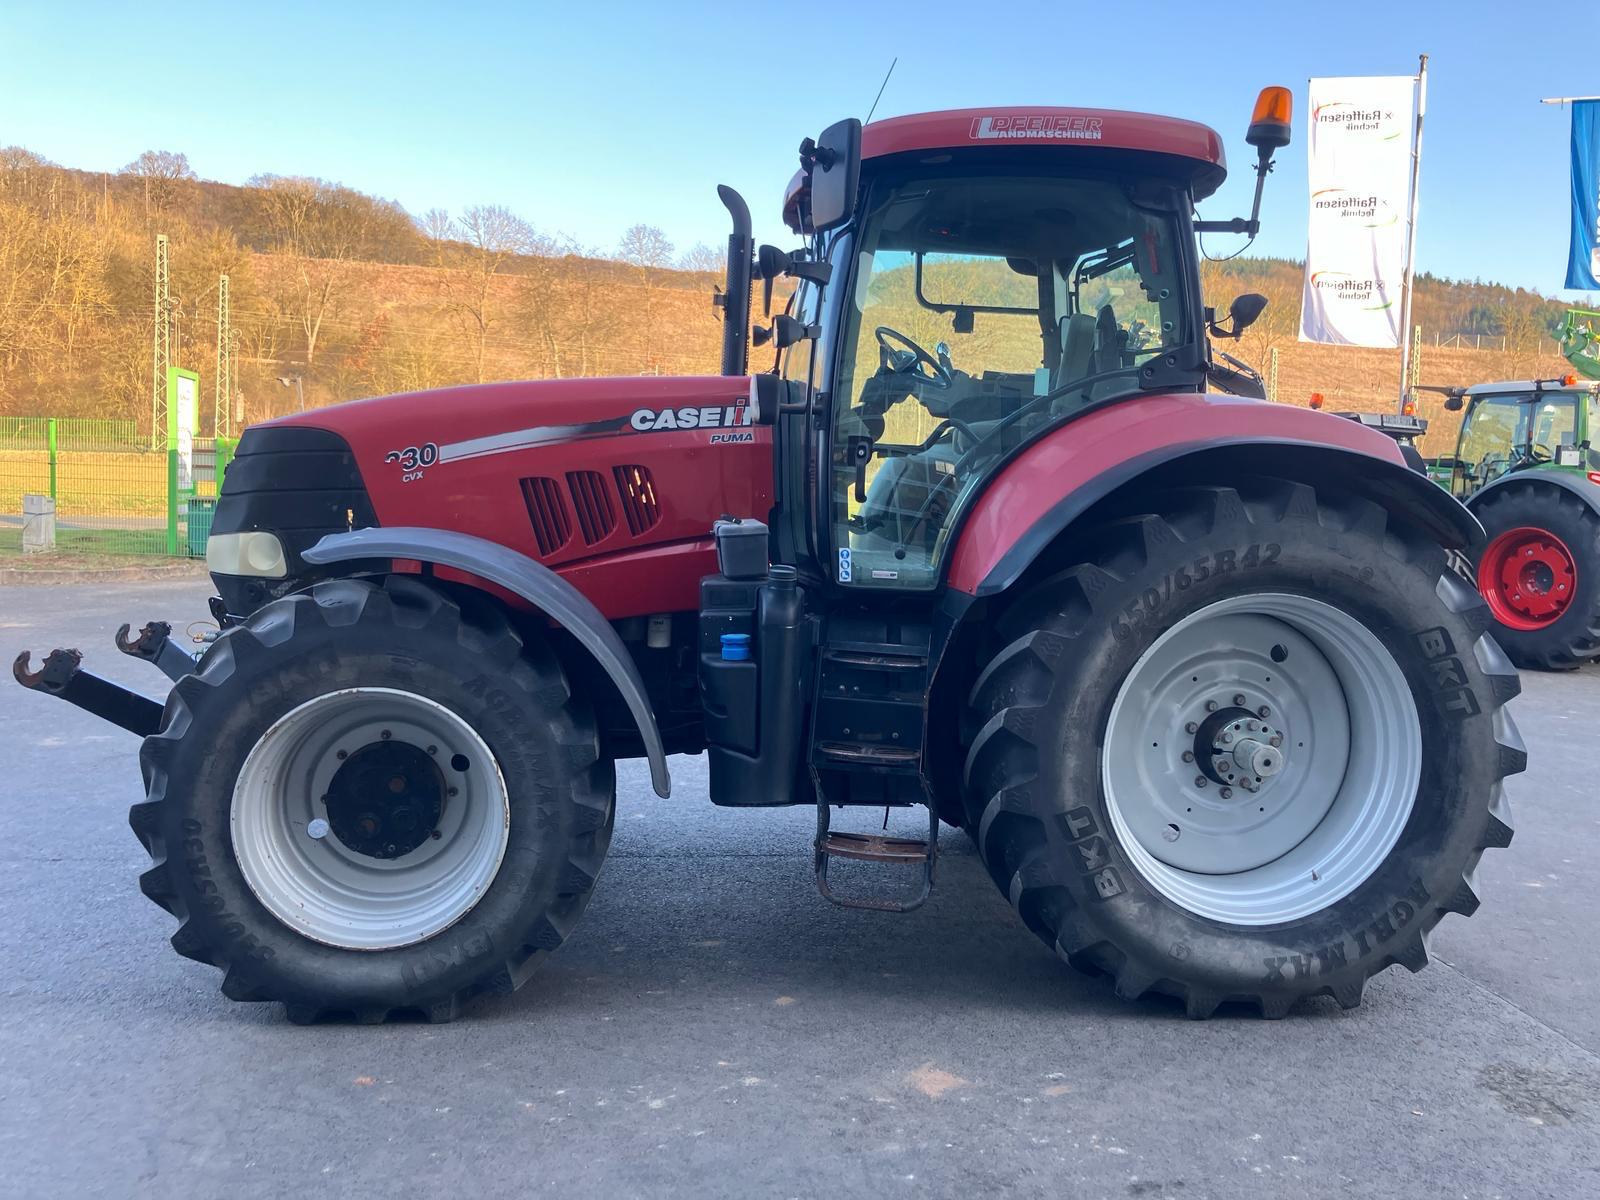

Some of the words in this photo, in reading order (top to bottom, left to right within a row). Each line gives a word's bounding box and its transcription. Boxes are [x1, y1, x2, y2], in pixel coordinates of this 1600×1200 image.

[991, 116, 1103, 131] PFEIFER
[710, 432, 753, 445] PUMA
[402, 471, 424, 483] CVX
[1109, 543, 1282, 643] 650/65R42
[1417, 627, 1480, 718] BKT
[1058, 806, 1127, 899] BKT
